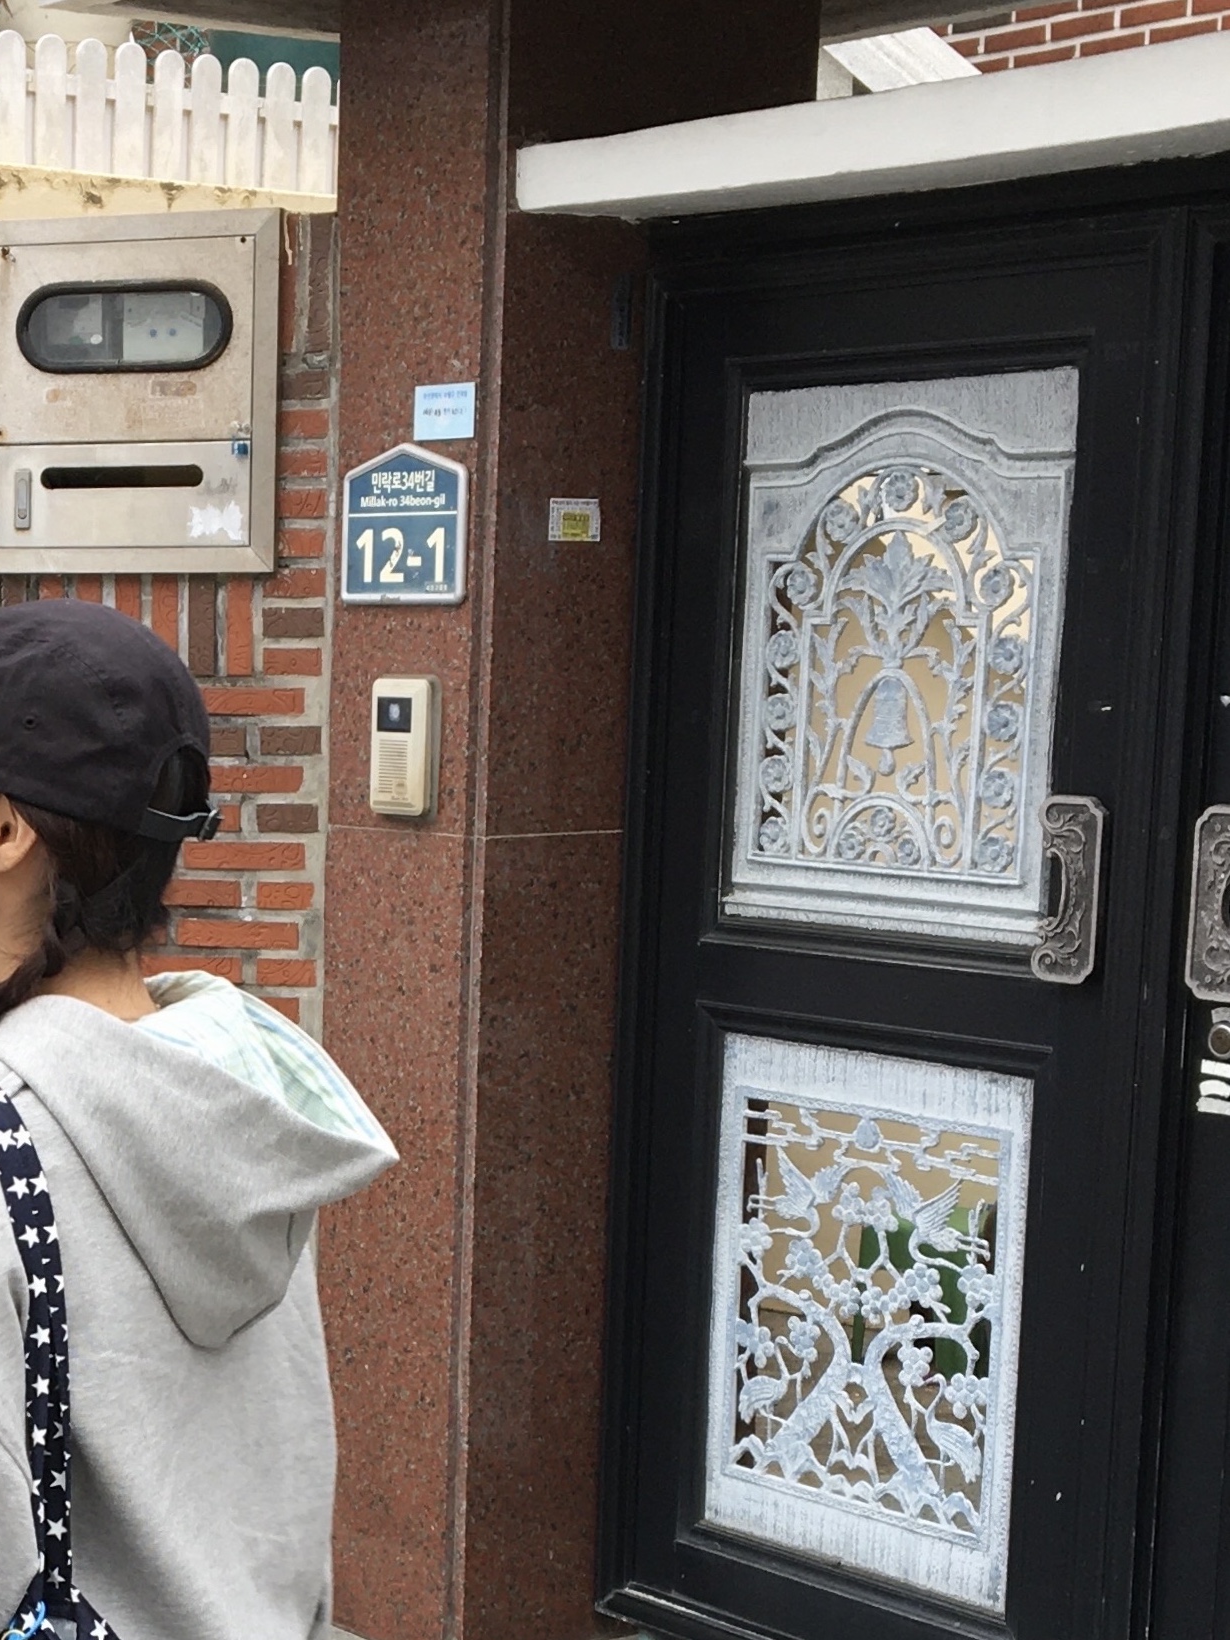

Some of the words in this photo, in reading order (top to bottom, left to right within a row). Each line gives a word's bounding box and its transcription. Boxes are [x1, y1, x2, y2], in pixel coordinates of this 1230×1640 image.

[372, 470, 435, 494] 민락로34번길
[360, 496, 398, 507] Millak-ro
[400, 493, 446, 508] 34beon-gil
[356, 527, 445, 583] 12-1
